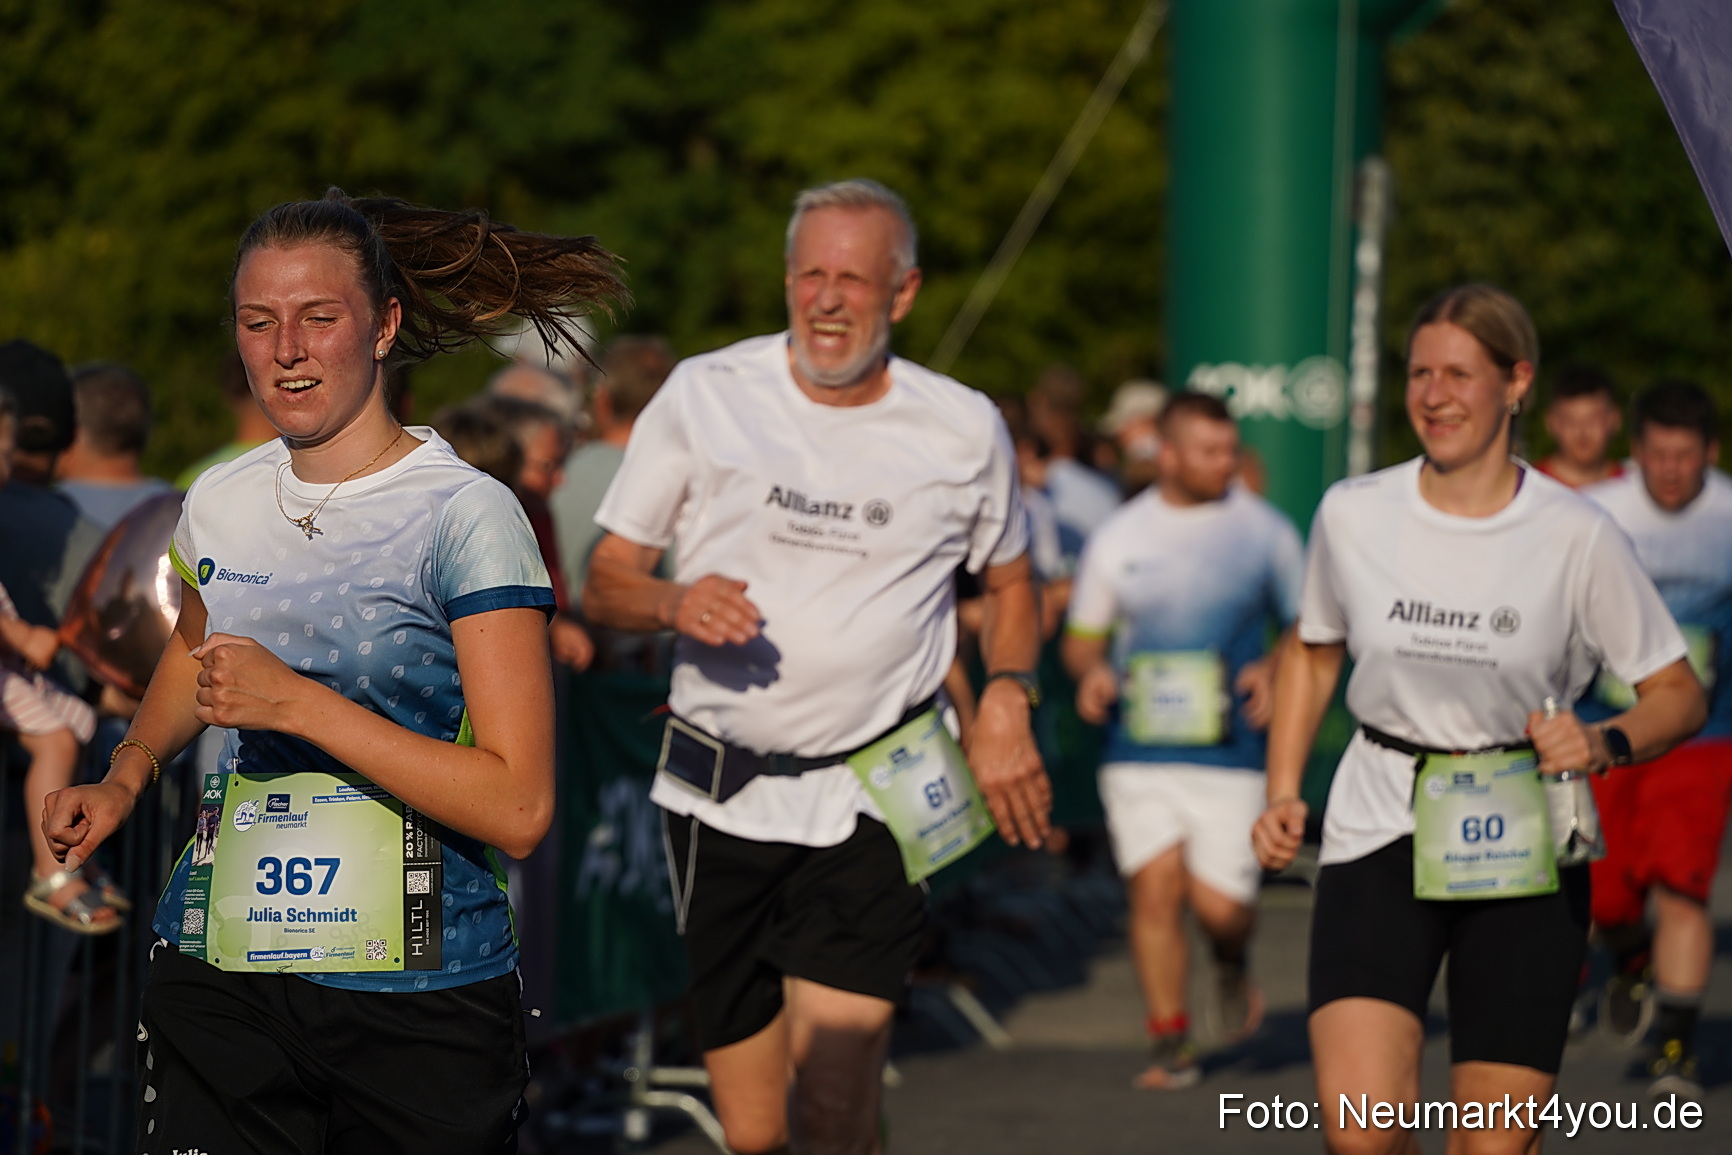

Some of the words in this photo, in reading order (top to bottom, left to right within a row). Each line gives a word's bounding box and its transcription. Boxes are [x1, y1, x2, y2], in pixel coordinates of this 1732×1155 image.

[765, 486, 853, 519] Allianz
[1388, 600, 1480, 628] Allianz
[203, 789, 223, 799] AOK
[924, 776, 952, 809] 61
[257, 811, 309, 823] Firmenlauf
[405, 805, 414, 830] RAB
[1462, 814, 1505, 843] 60
[405, 842, 414, 859] 20
[256, 856, 341, 895] 367
[246, 907, 283, 922] Julia
[286, 907, 358, 922] Schmidt
[411, 899, 423, 956] HILTL
[250, 952, 308, 961] firmenlauf.bayern
